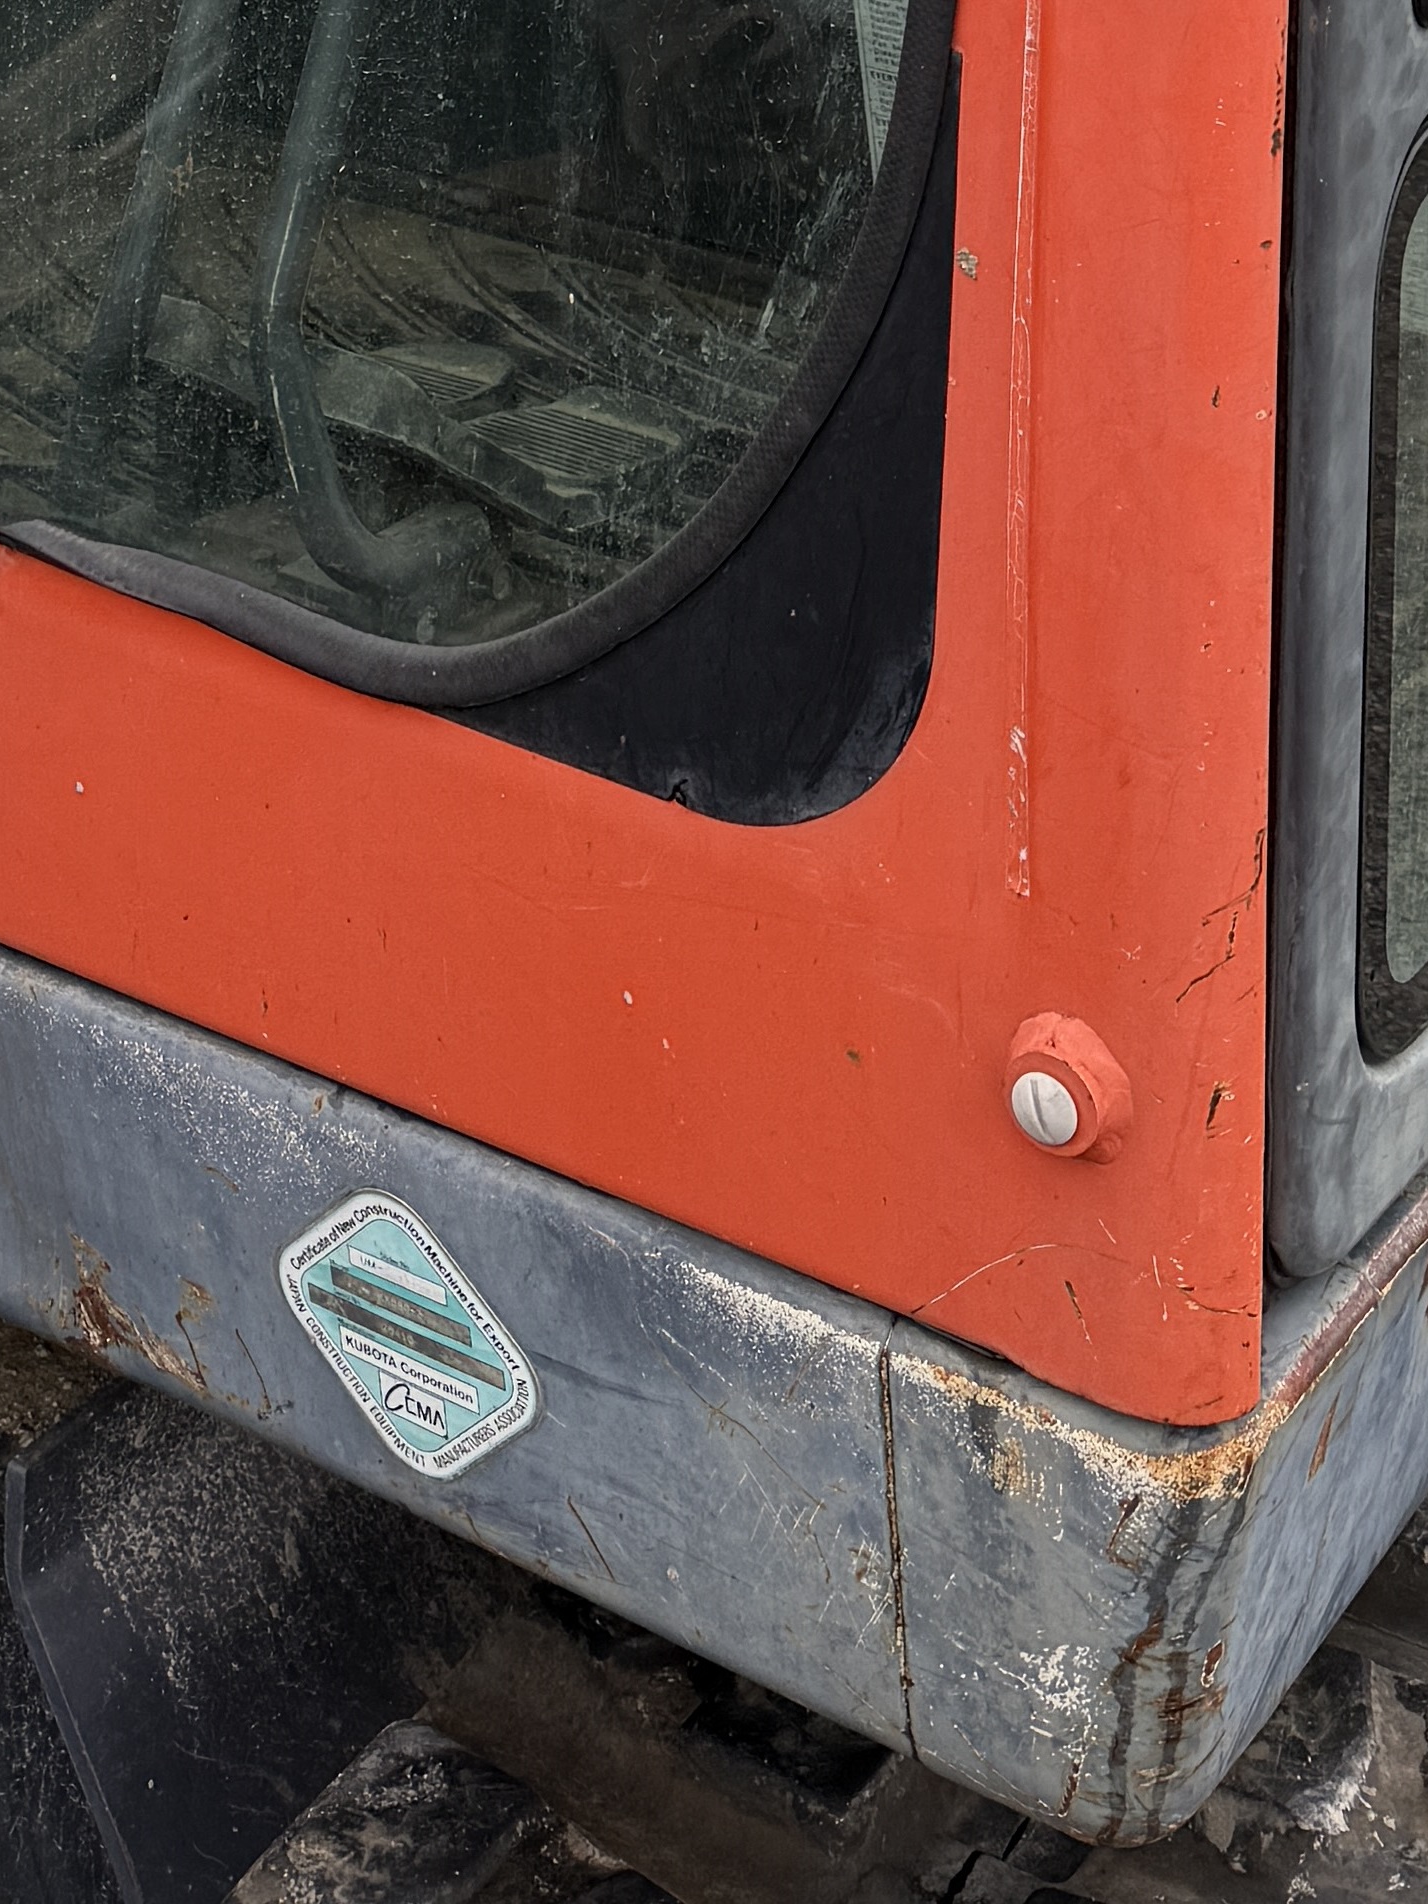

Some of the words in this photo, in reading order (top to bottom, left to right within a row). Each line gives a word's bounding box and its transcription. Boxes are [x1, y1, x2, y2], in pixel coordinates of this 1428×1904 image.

[290, 1235, 331, 1271] Certificate
[329, 1225, 339, 1242] of
[337, 1218, 356, 1237] New
[353, 1204, 426, 1248] Construction
[424, 1244, 470, 1302] Machine
[466, 1300, 484, 1323] for
[481, 1323, 521, 1371] Export
[306, 1315, 370, 1404] CONSTRUCTION
[370, 1407, 427, 1467] EQUIPMENT
[433, 1422, 496, 1469] MANUFACTURERS
[493, 1378, 529, 1432] ASSOCIATION
[345, 1333, 398, 1368] KUBOTA
[400, 1360, 474, 1405] Corporation
